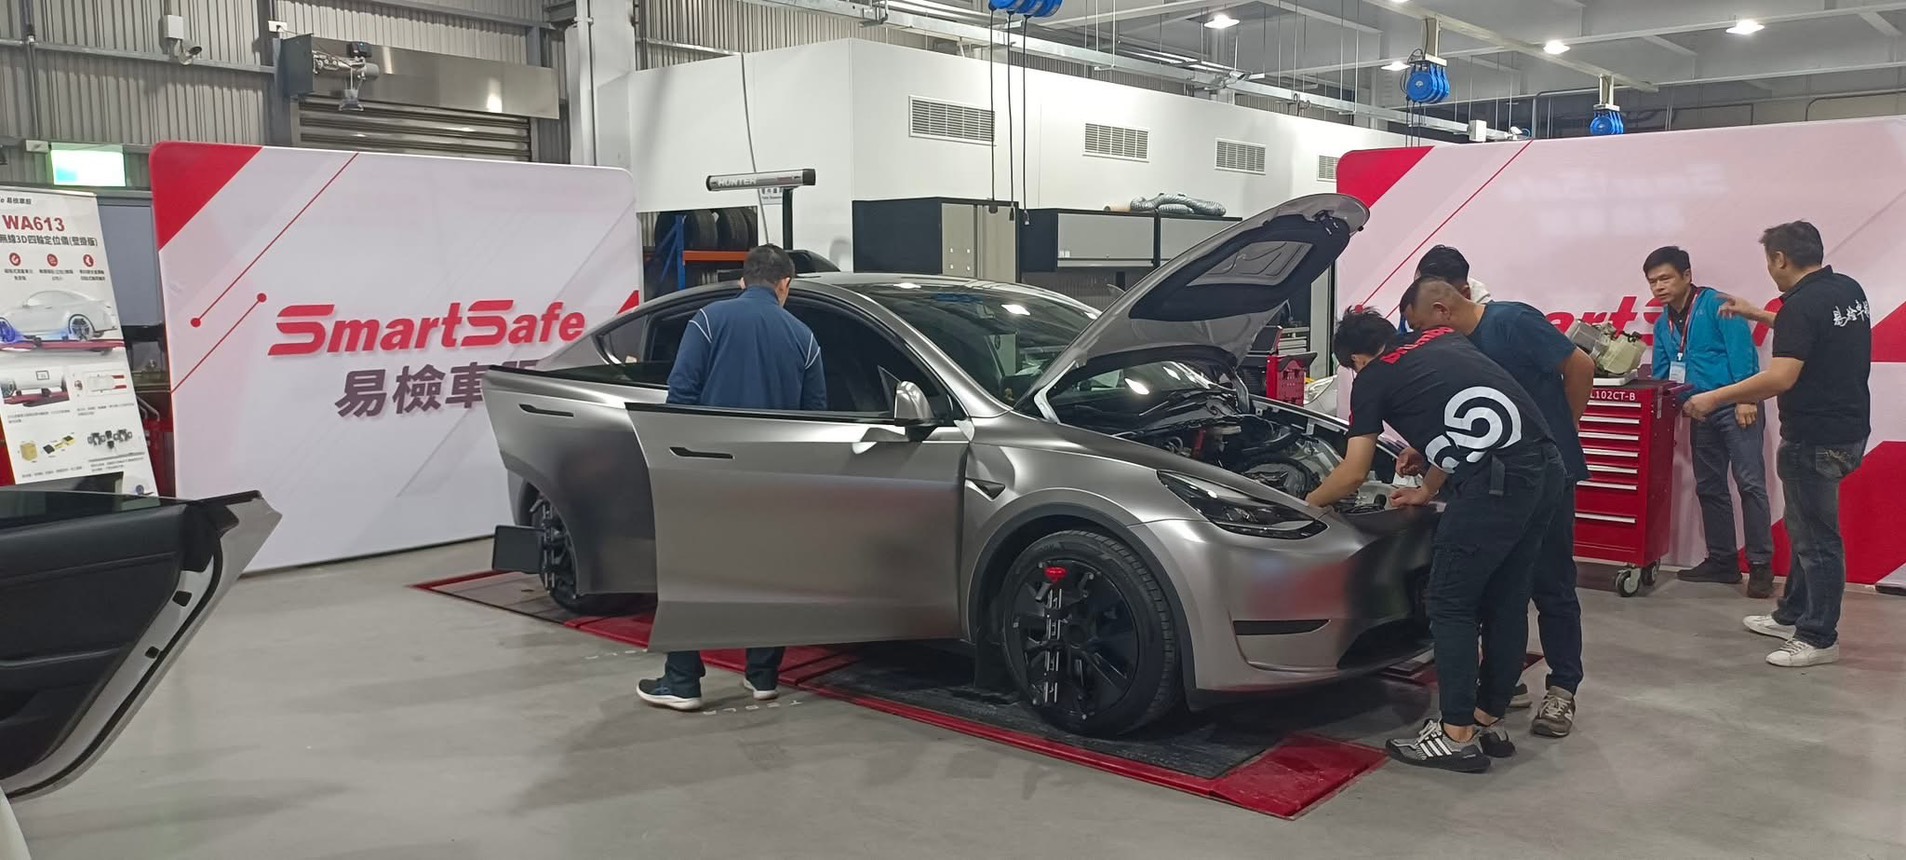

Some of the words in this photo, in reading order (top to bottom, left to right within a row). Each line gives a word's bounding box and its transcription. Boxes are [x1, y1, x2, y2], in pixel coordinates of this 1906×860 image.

[718, 179, 757, 187] HUNTER
[2, 215, 65, 231] WA613
[268, 300, 585, 356] SmartSafe
[335, 360, 540, 417] 易檢車
